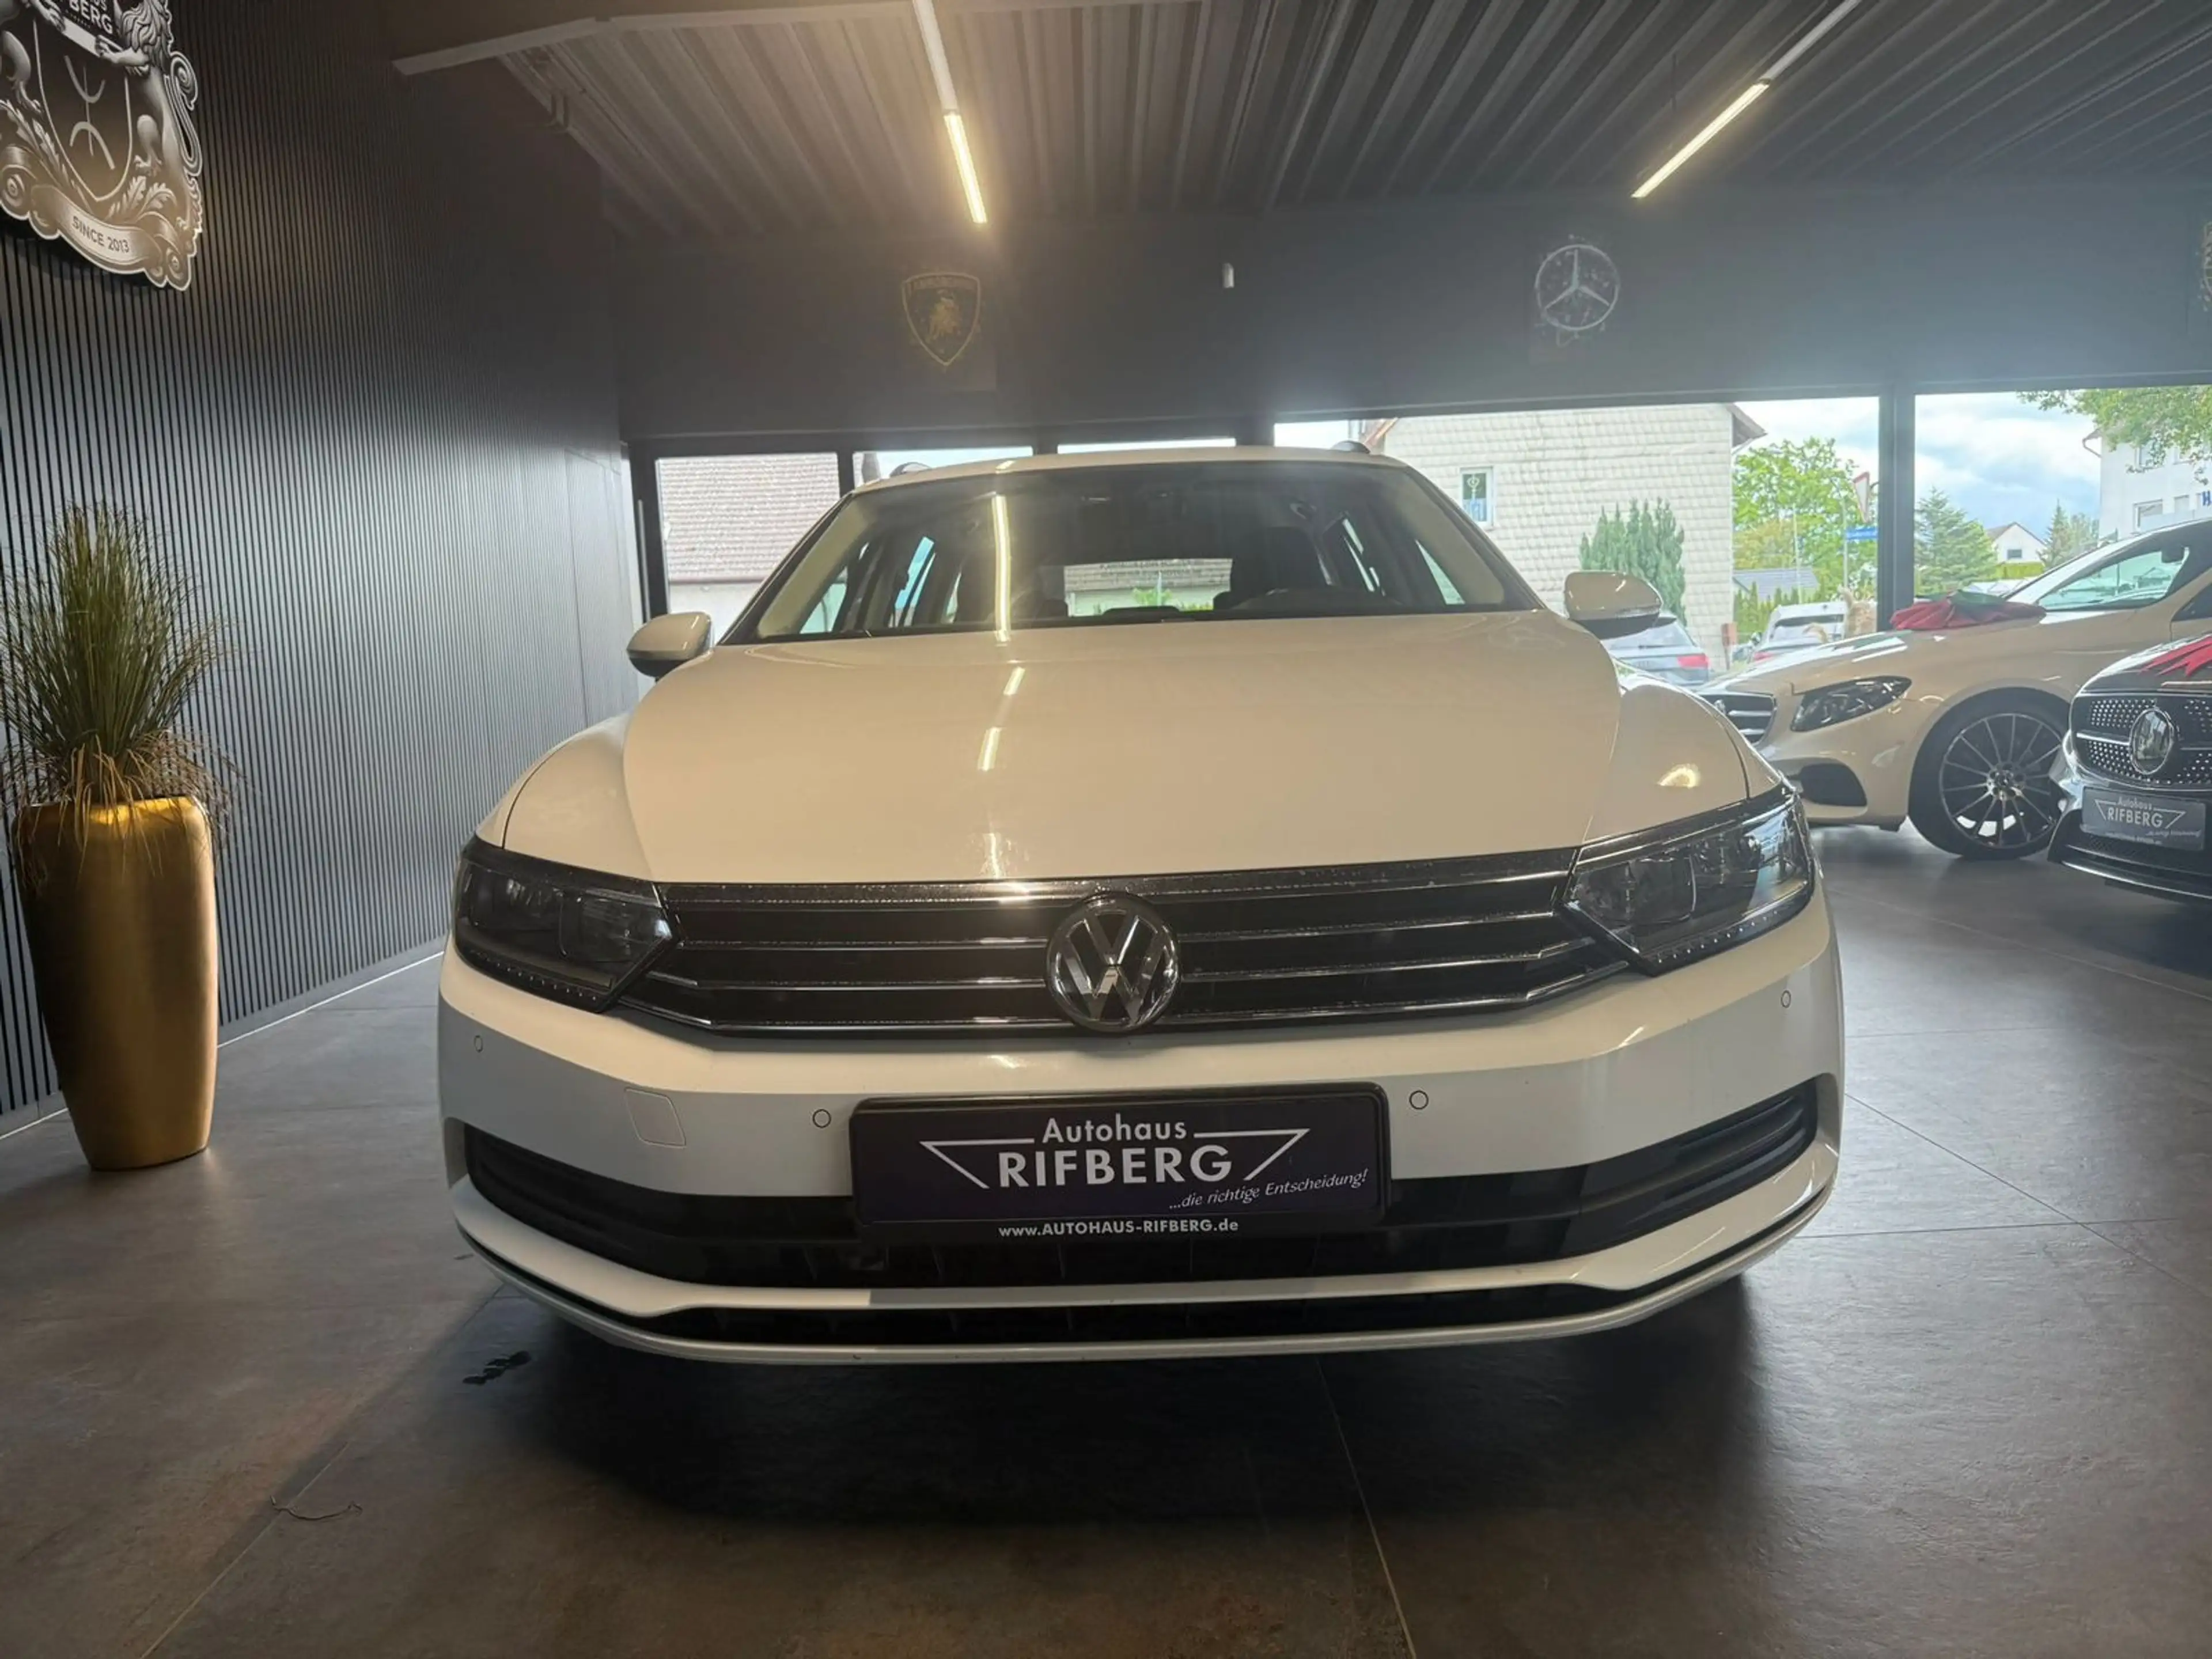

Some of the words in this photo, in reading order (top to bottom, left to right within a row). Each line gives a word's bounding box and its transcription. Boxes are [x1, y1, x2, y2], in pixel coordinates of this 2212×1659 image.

[71, 215, 105, 247] SINCE
[107, 235, 130, 253] 2013
[2107, 806, 2164, 828] RIFBERG
[1041, 1113, 1187, 1143] Autohaus
[998, 1144, 1233, 1189] RIFBERG
[1207, 1184, 1260, 1205] richtige
[1264, 1167, 1369, 1196] Entscheidung!
[998, 1218, 1239, 1237] www.AUTOHAUS-RIFBERG.de
